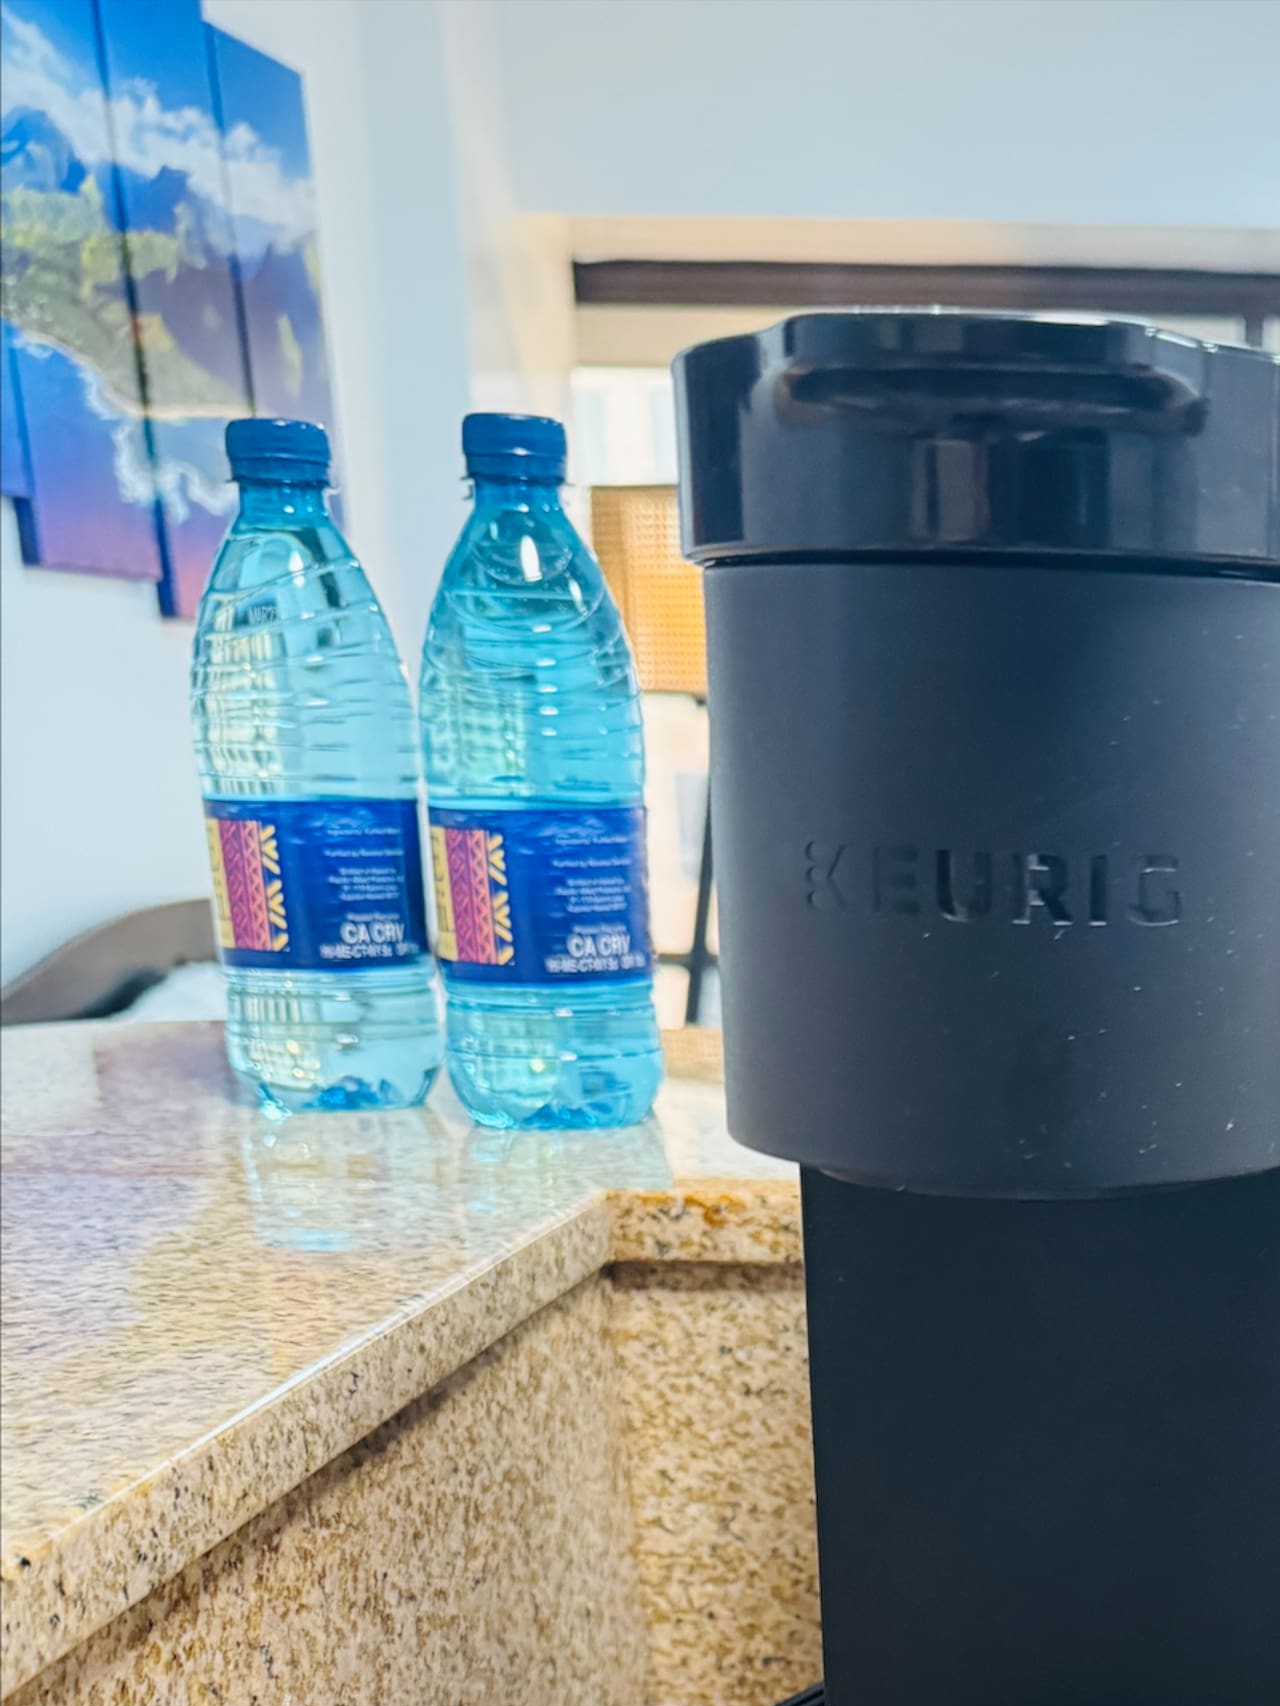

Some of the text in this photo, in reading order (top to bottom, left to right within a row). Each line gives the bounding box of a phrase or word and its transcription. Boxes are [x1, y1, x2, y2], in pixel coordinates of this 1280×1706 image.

[804, 840, 1182, 927] KEURIG
[340, 921, 405, 944] CA CRV
[566, 933, 630, 958] CA CRV
